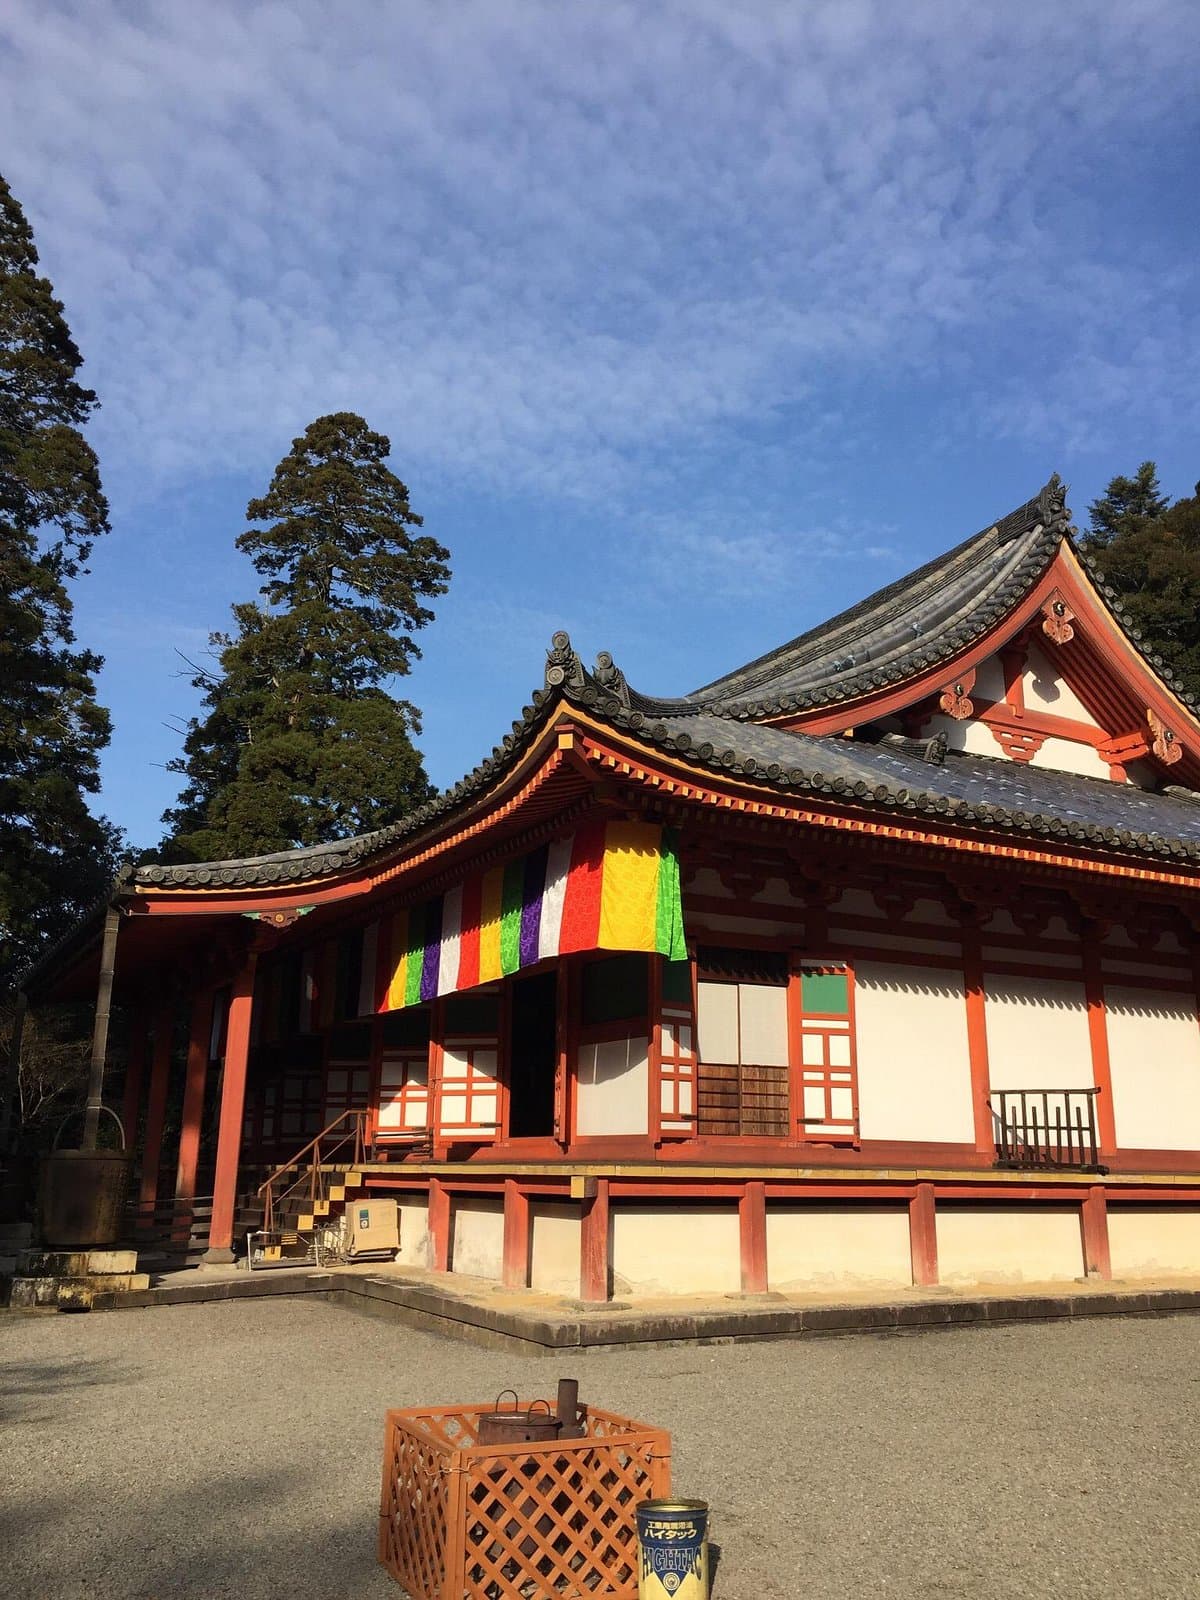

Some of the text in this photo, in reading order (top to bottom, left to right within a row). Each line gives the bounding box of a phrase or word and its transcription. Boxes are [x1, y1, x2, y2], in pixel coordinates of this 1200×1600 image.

[644, 1529, 697, 1539] ハイタック
